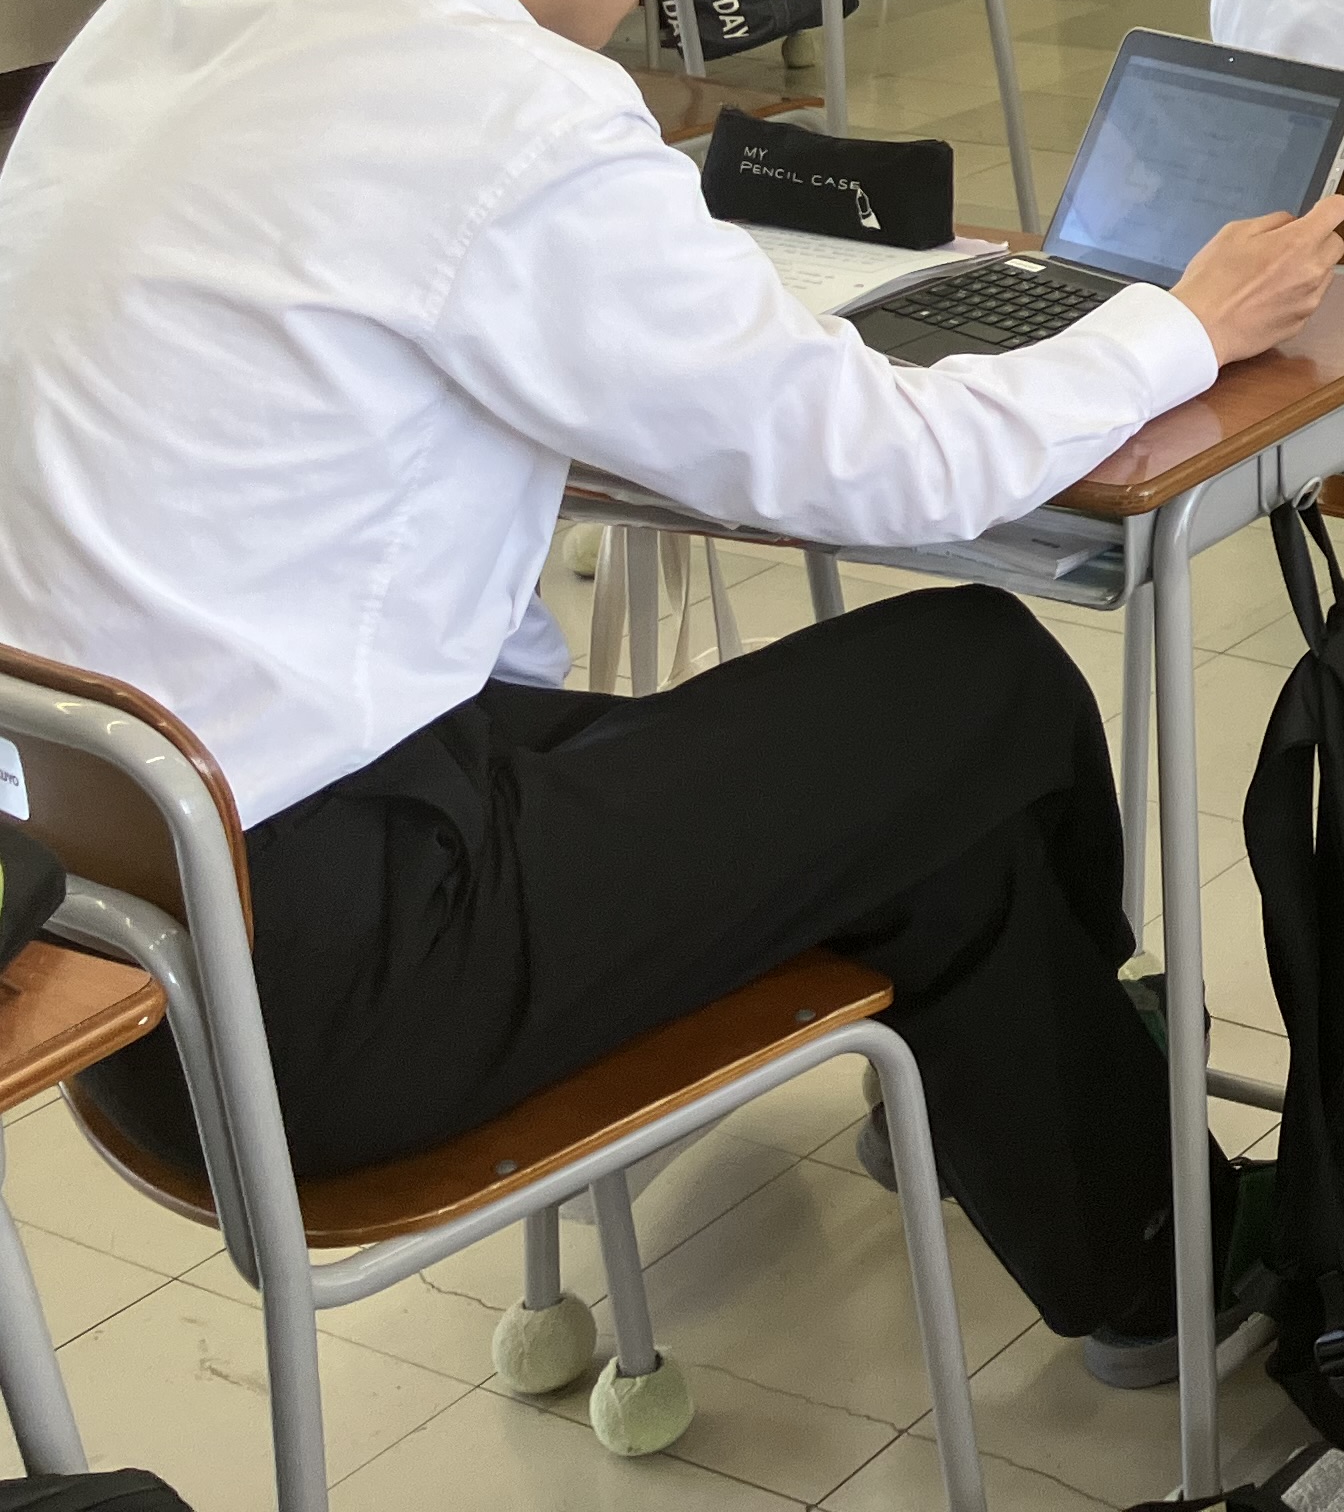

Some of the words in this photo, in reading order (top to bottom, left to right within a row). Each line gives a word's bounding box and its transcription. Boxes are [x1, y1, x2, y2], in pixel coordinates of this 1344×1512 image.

[743, 146, 769, 161] MY
[739, 160, 804, 184] PENCIL
[811, 174, 861, 191] CASE
